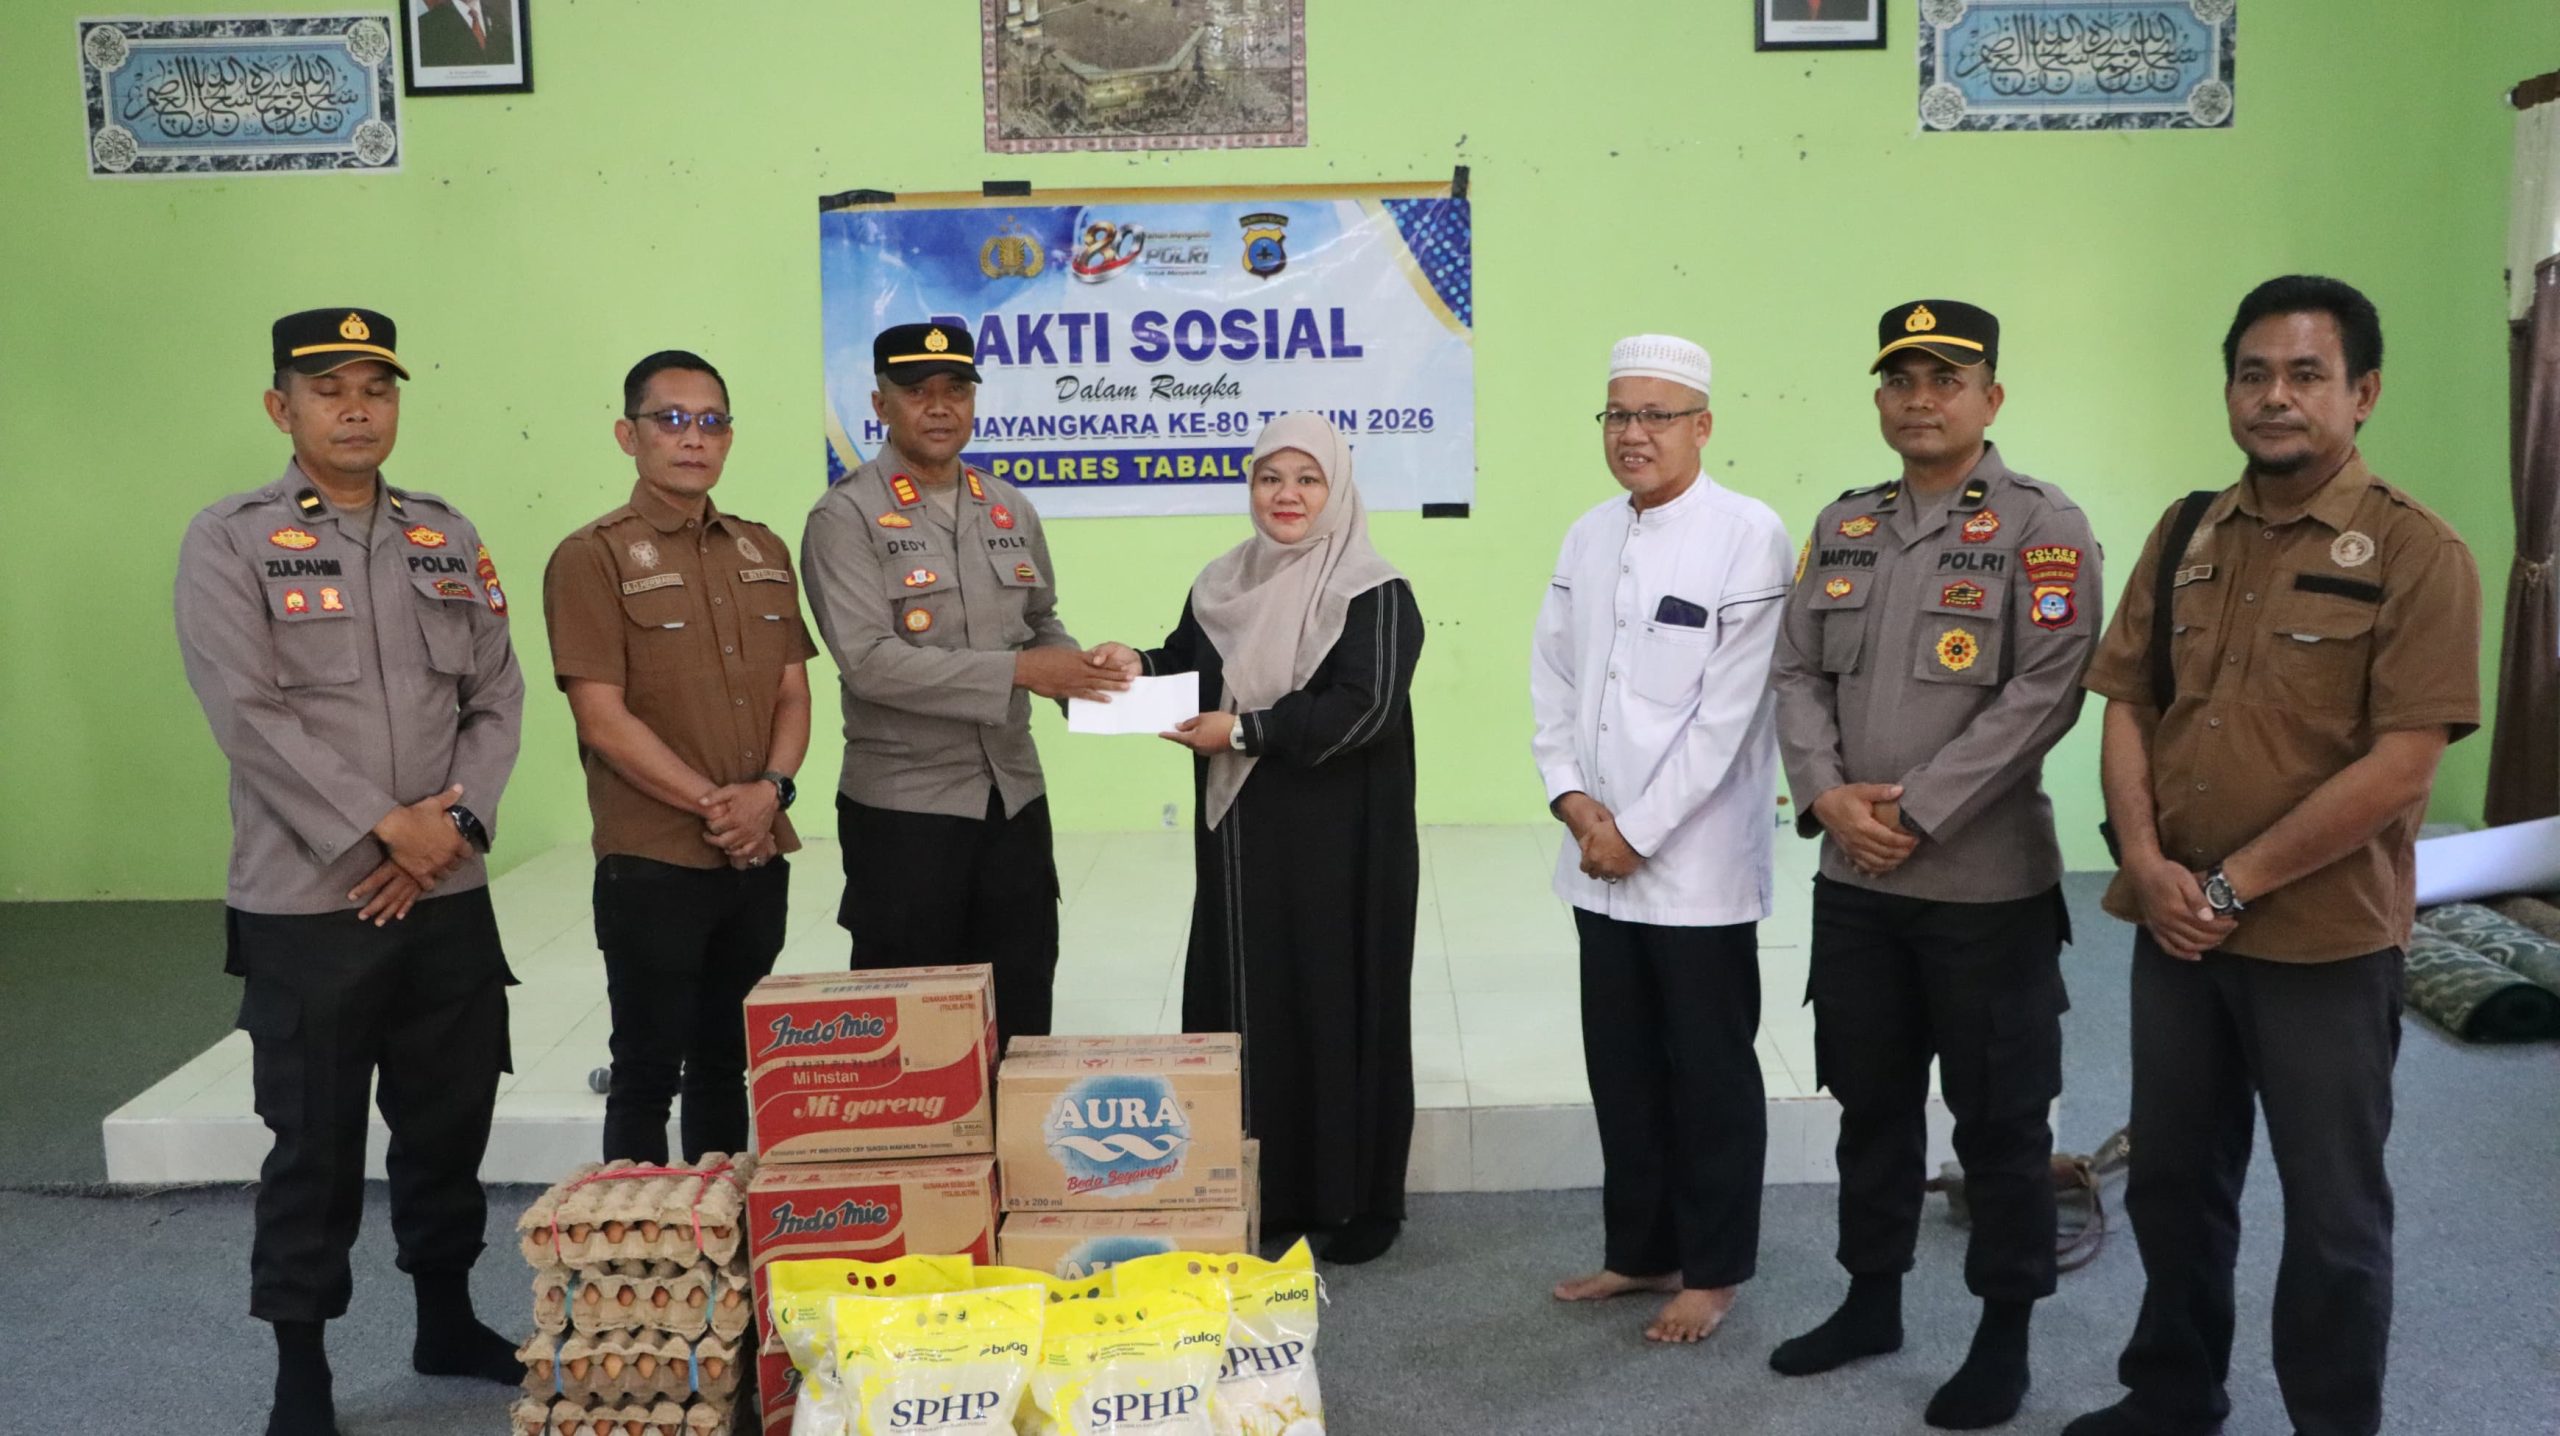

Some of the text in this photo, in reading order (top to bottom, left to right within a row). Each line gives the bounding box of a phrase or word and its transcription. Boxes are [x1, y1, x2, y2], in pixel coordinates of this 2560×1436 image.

[1145, 247, 1209, 264] POLRI
[931, 308, 1363, 366] AKTI SOSIAL
[1056, 373, 1241, 404] Dalam Rangka
[972, 412, 1159, 438] AYANGKARA
[1169, 411, 1248, 434] KE-80
[1368, 408, 1434, 430] 2026
[993, 455, 1253, 481] POLRES TABAL
[887, 541, 927, 554] DEDY
[988, 537, 1027, 550] POLR
[2025, 547, 2076, 559] POLRES
[2026, 555, 2076, 565] TABALONG
[408, 556, 467, 574] POLRI
[1938, 552, 2005, 573] POLRI
[793, 1071, 859, 1085] Mi Instan
[793, 1095, 946, 1122] Mi goreng
[1054, 1096, 1185, 1129] AURA
[1067, 1175, 1104, 1191] Beda
[1032, 1198, 1049, 1206] 200
[1051, 1198, 1063, 1206] ml
[1274, 1288, 1309, 1303] bulog
[1184, 1332, 1221, 1346] bulog
[890, 1390, 999, 1427] SPHP
[1092, 1384, 1199, 1428] SPHP
